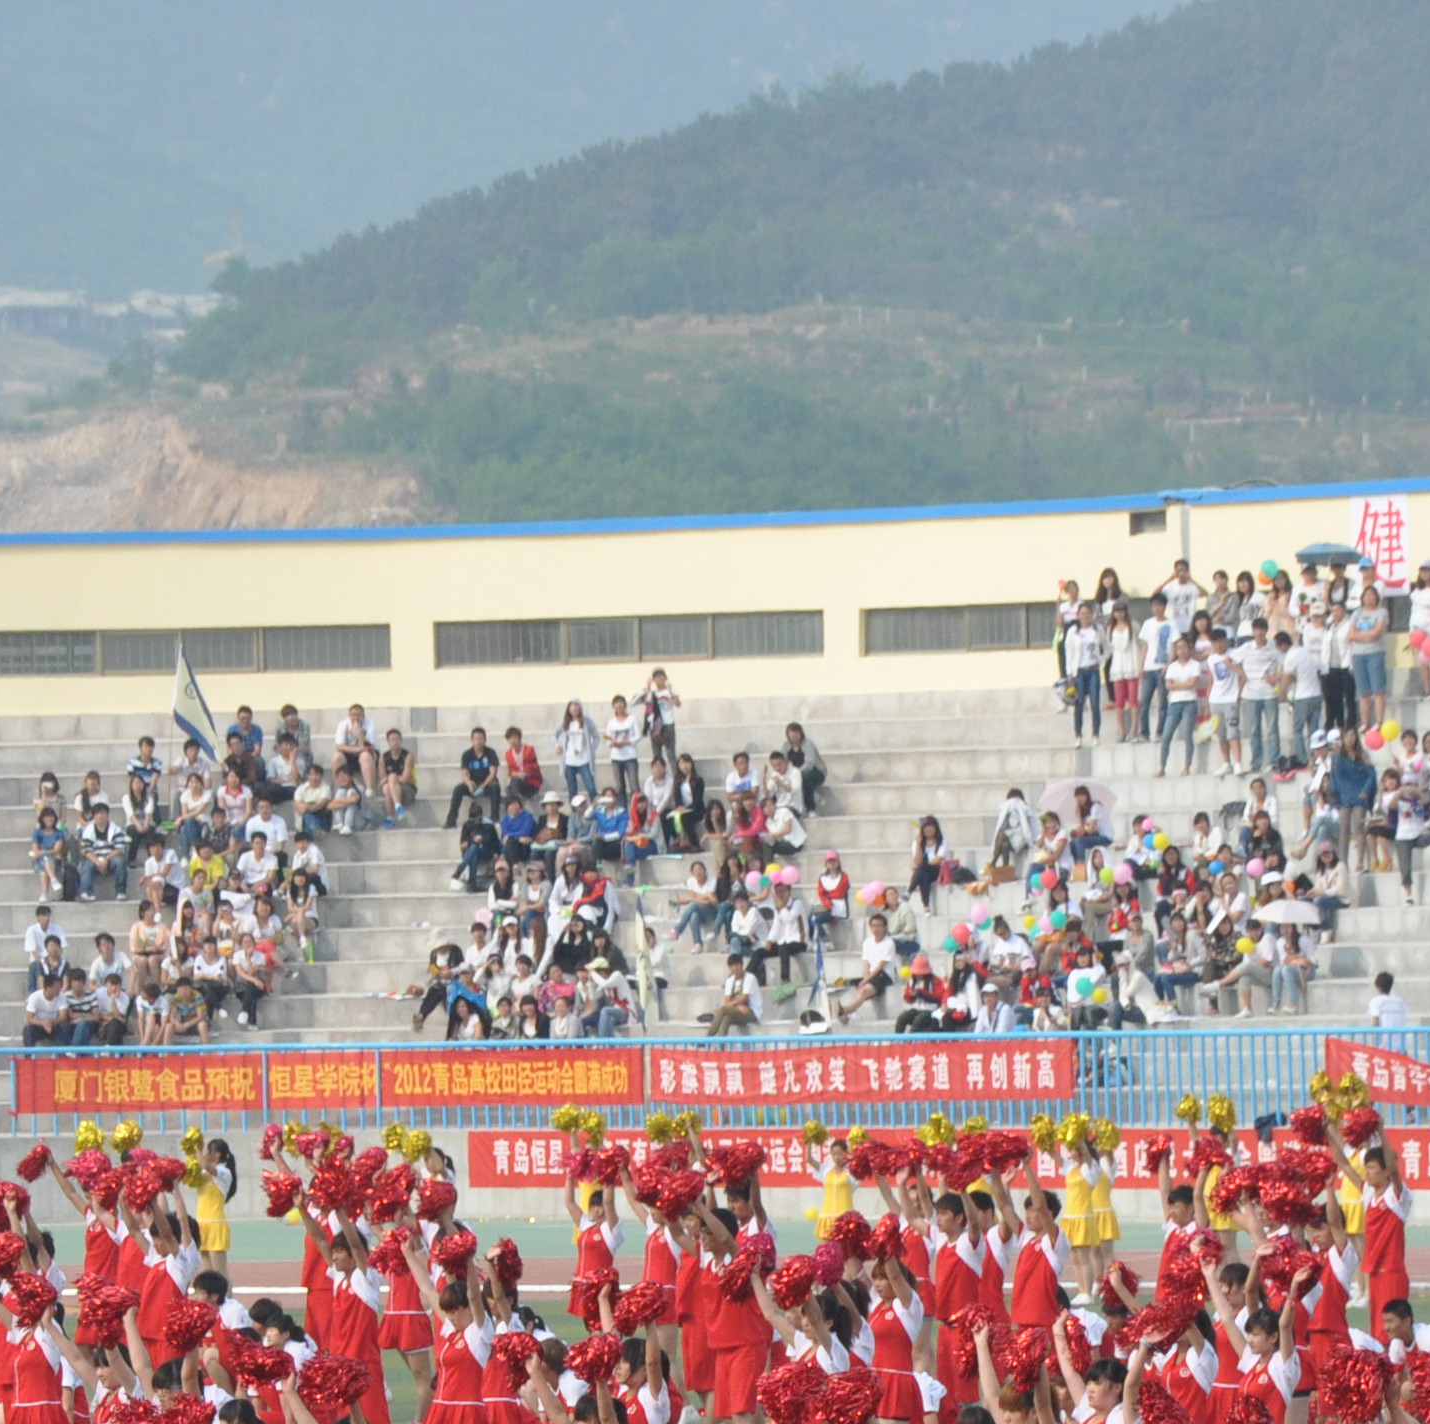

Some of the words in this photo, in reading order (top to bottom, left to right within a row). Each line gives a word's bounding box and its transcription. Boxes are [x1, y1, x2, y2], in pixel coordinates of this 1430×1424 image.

[1354, 498, 1407, 588] 健
[660, 1059, 745, 1096] 彩旗飘飘
[758, 1056, 847, 1095] 健儿欢笑
[861, 1052, 951, 1092] 飞驰赛道
[965, 1049, 1056, 1090] 再创新高
